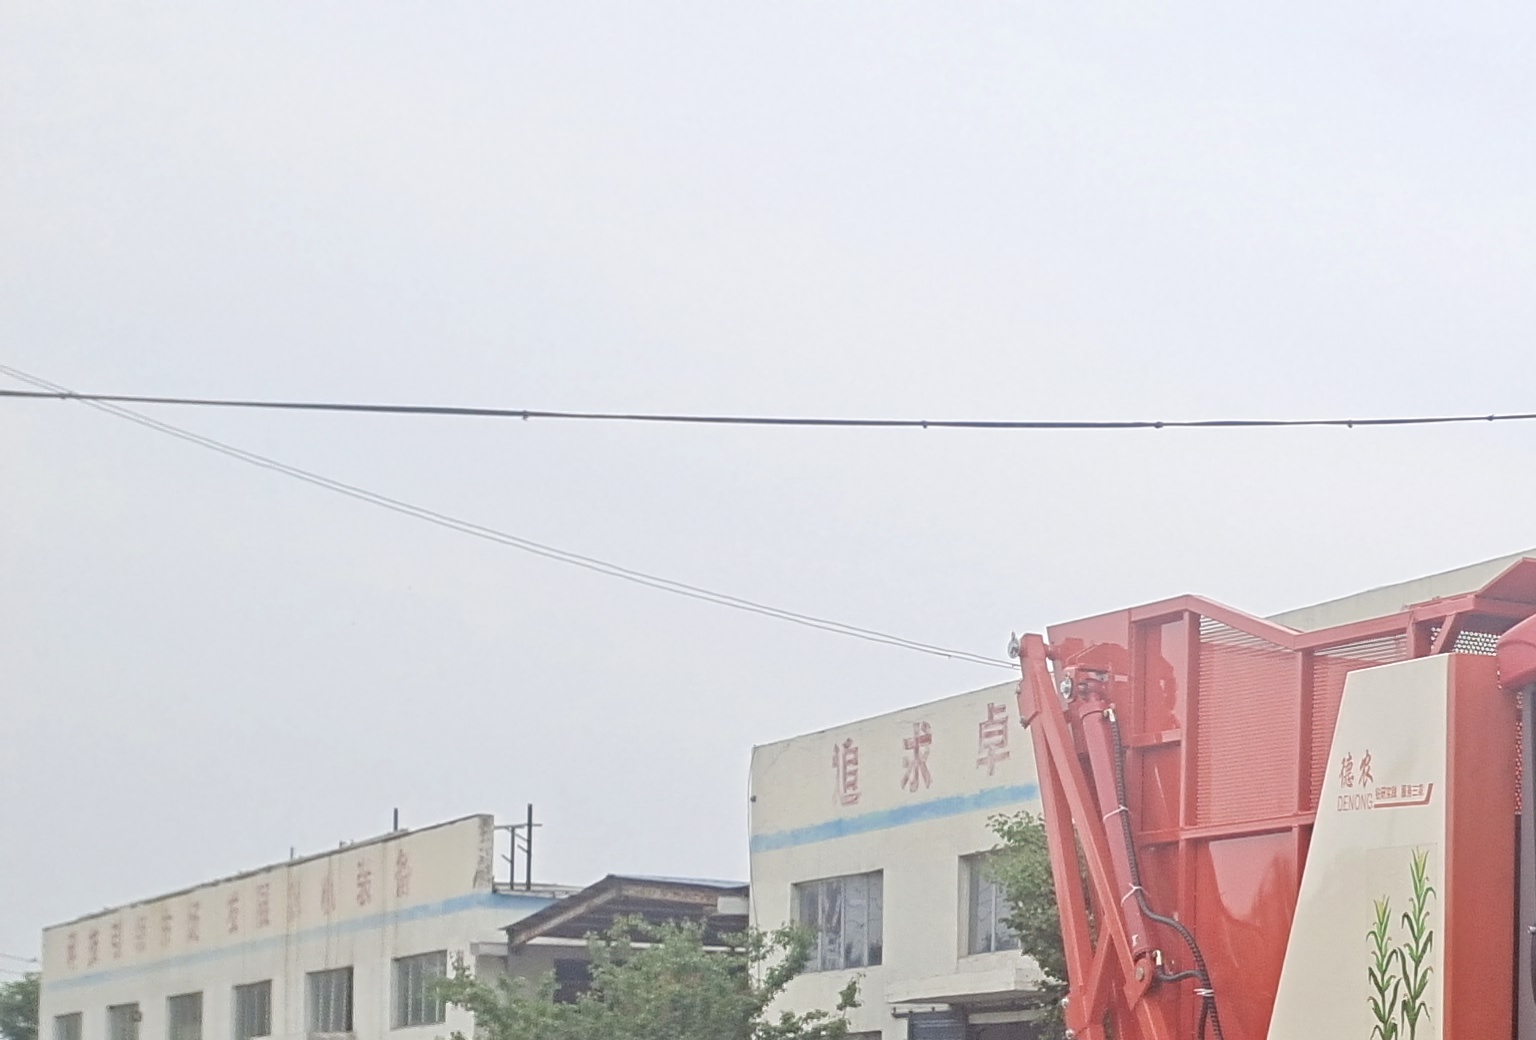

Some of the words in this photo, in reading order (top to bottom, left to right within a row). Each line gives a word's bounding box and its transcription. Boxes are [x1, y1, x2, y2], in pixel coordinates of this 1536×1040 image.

[832, 702, 1011, 806] 追求卓
[1337, 793, 1373, 812] DENONG
